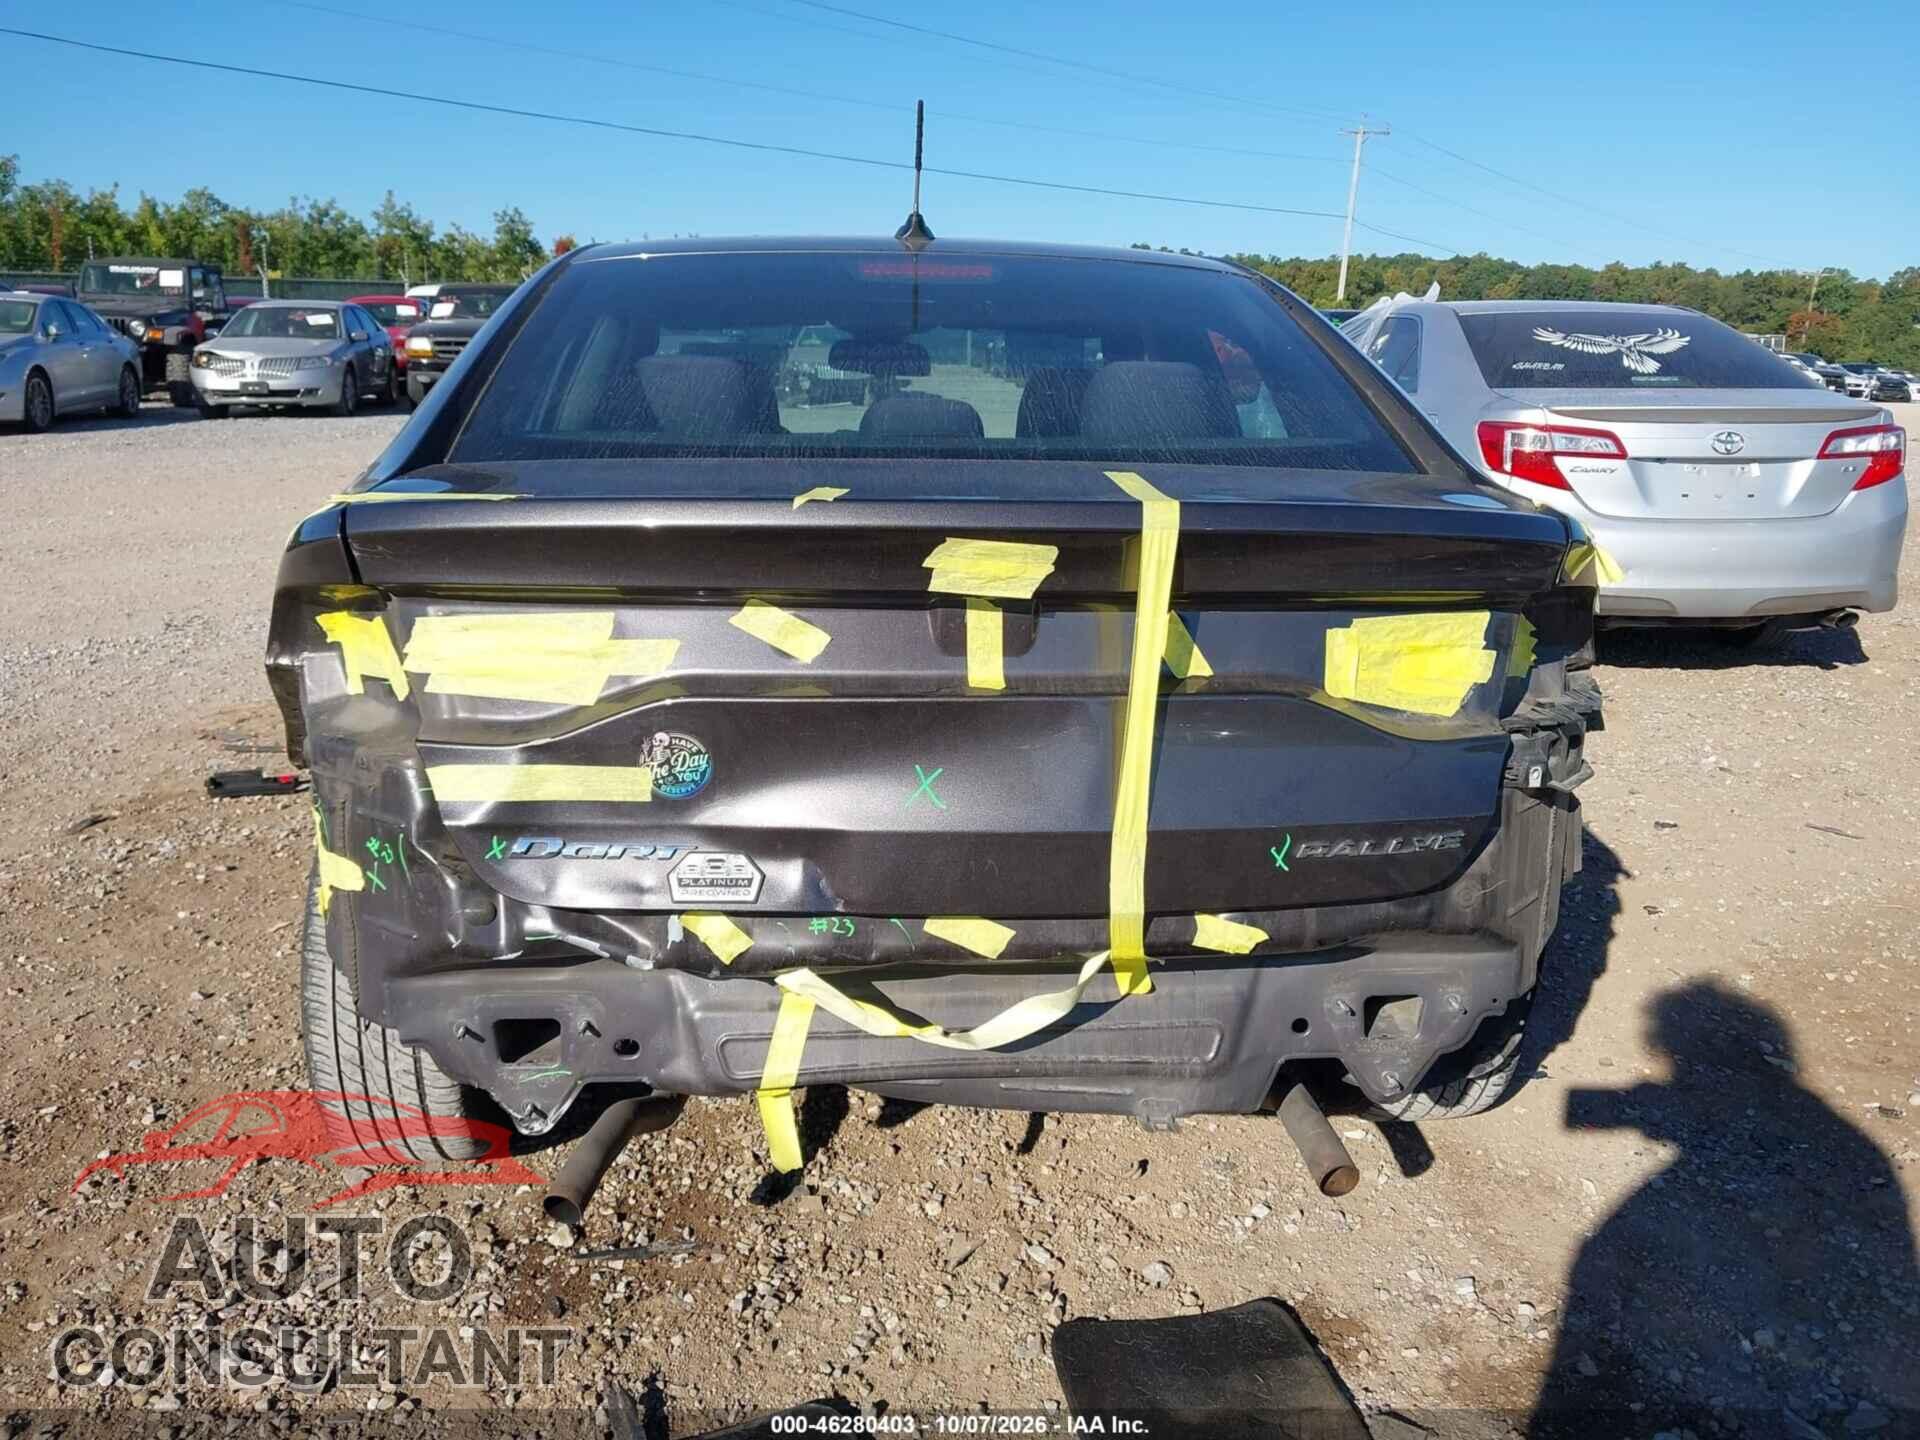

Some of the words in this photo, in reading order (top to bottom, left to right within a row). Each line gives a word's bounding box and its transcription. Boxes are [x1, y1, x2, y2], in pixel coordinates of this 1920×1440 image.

[671, 738, 699, 754] HAVE
[671, 750, 709, 774] Day
[676, 771, 701, 782] YOU
[680, 878, 749, 887] PLATINUM
[808, 917, 855, 938] #23
